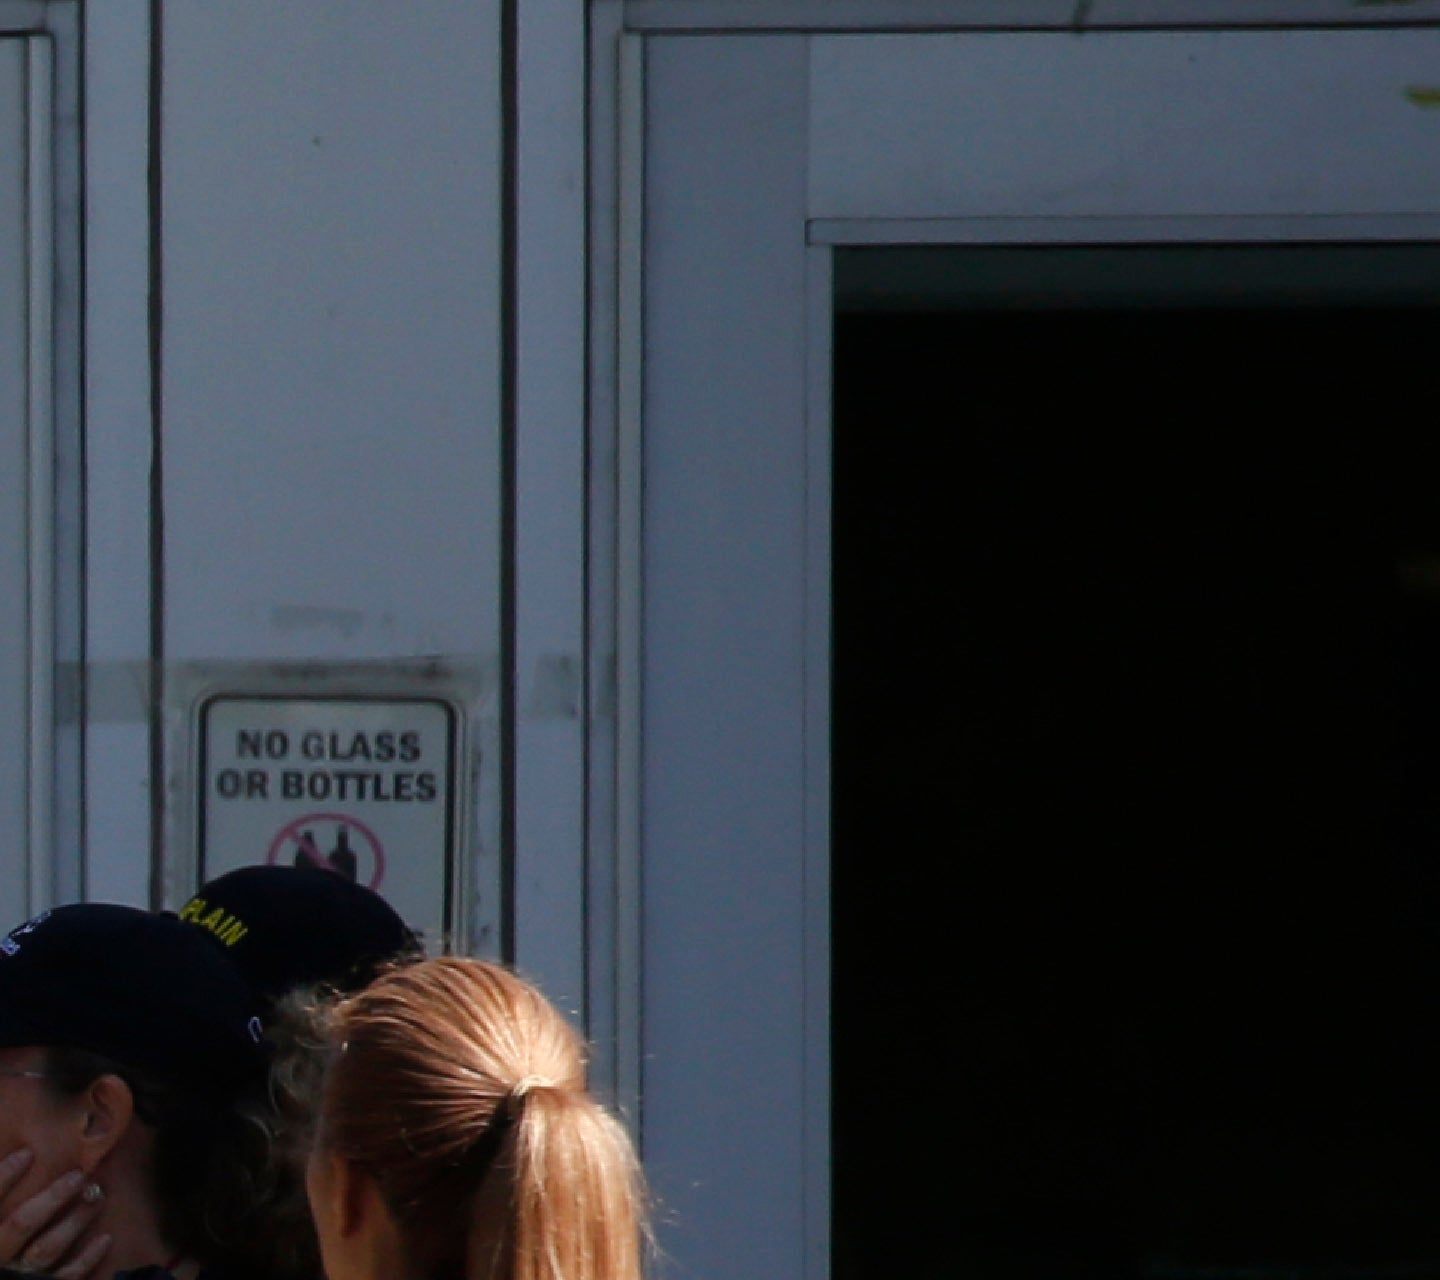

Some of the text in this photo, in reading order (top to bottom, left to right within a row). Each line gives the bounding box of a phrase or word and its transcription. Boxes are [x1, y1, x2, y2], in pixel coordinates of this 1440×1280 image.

[237, 729, 422, 762] NO GLASS
[217, 769, 437, 802] OR BOTTLES
